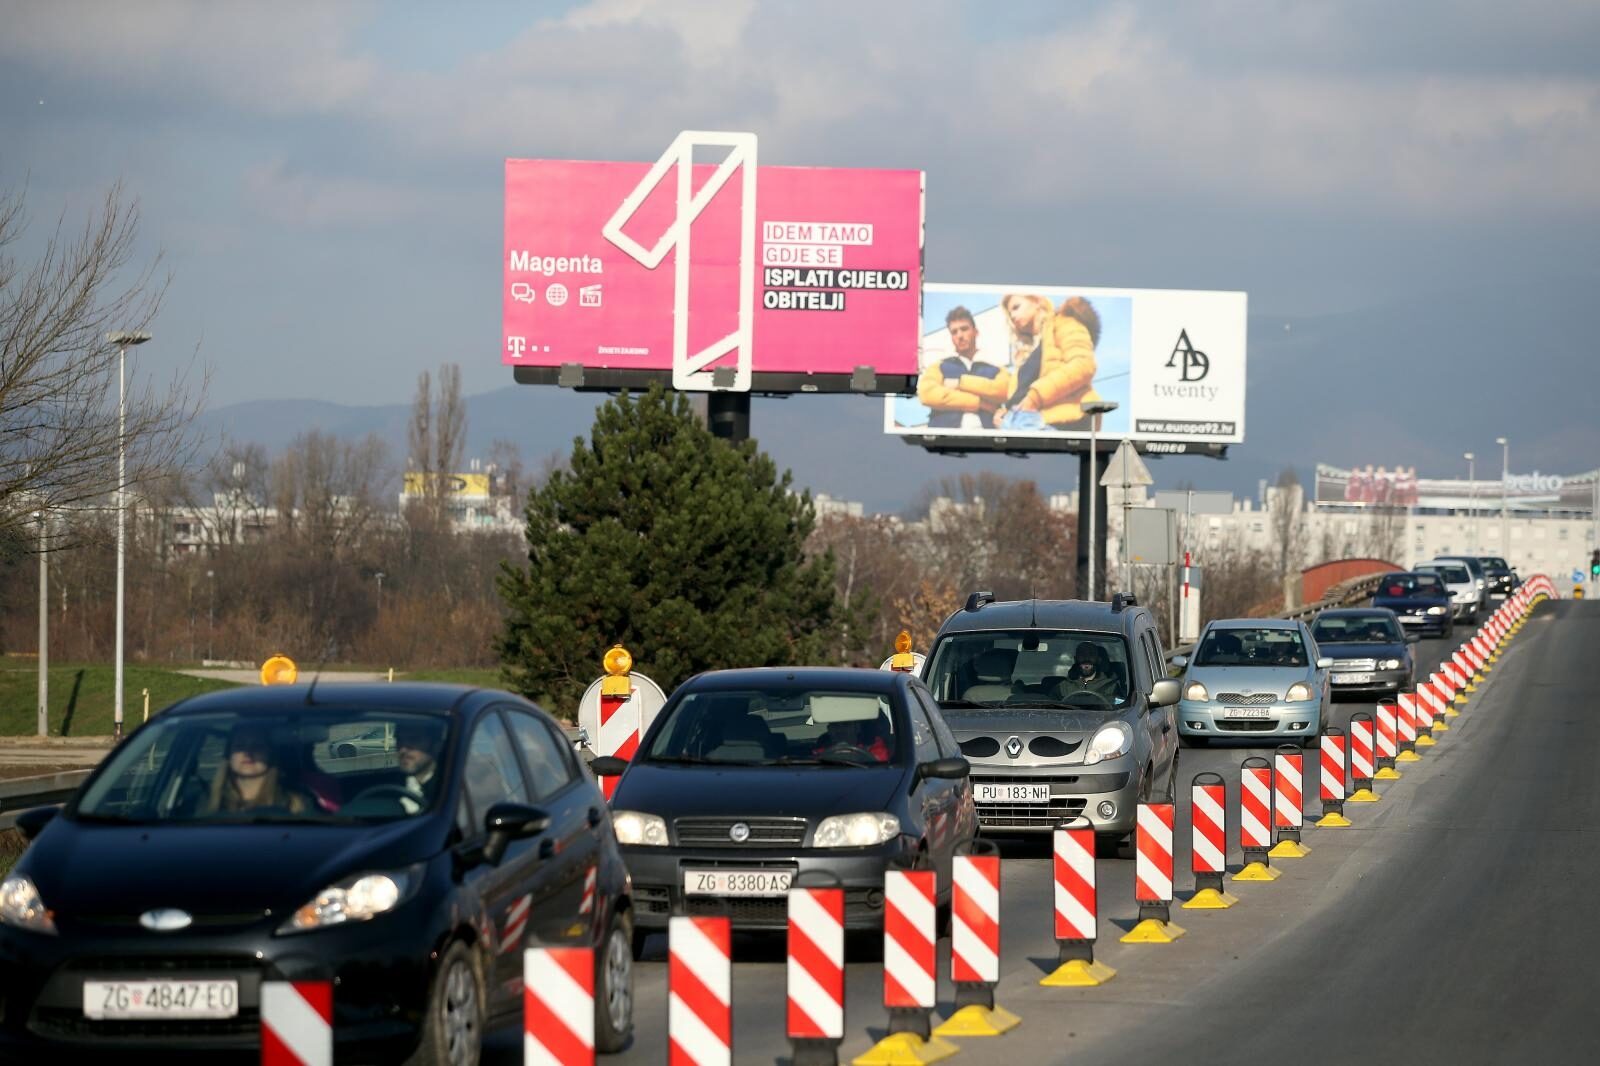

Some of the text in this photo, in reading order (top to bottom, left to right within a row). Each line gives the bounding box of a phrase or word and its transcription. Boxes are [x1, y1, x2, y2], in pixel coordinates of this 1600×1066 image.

[767, 225, 869, 242] IDEM TAMO
[510, 250, 603, 276] Magenta
[766, 247, 838, 264] GDJE SE
[765, 268, 908, 289] ISPLATI CIJELOJ
[764, 290, 845, 310] OBITELJI
[1153, 383, 1218, 402] twenty
[1138, 422, 1233, 434] www.europa92.hr
[982, 786, 1047, 799] PU 183-NH
[697, 874, 716, 891] ZG
[103, 984, 129, 1010] ZG
